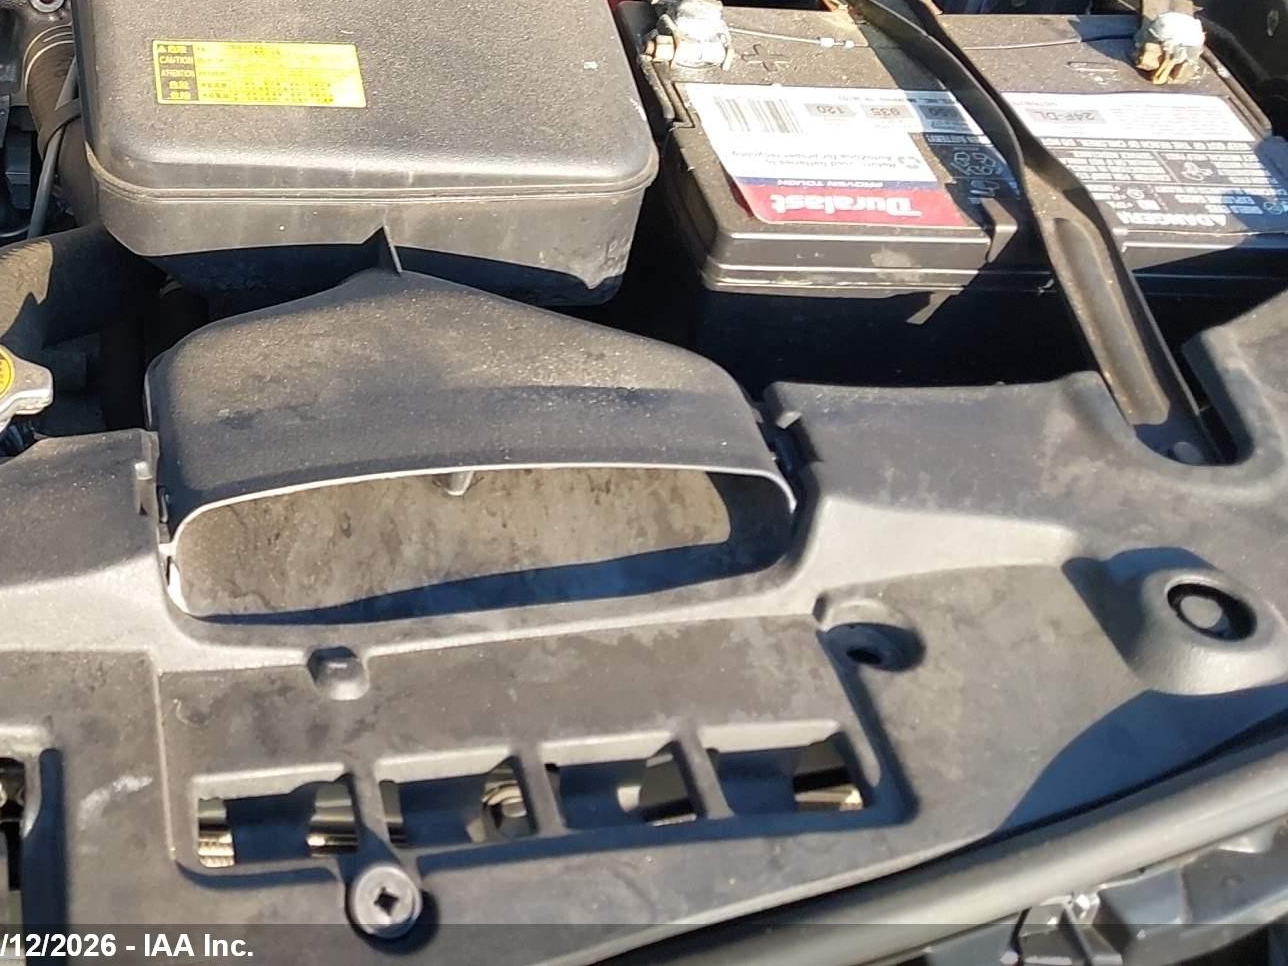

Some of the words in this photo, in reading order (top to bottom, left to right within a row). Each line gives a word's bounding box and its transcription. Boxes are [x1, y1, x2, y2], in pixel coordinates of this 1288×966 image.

[816, 105, 845, 114] 120
[870, 107, 900, 116] 935
[777, 179, 824, 188] TOUGH
[825, 180, 883, 188] PROVEN
[770, 194, 922, 217] Duralast
